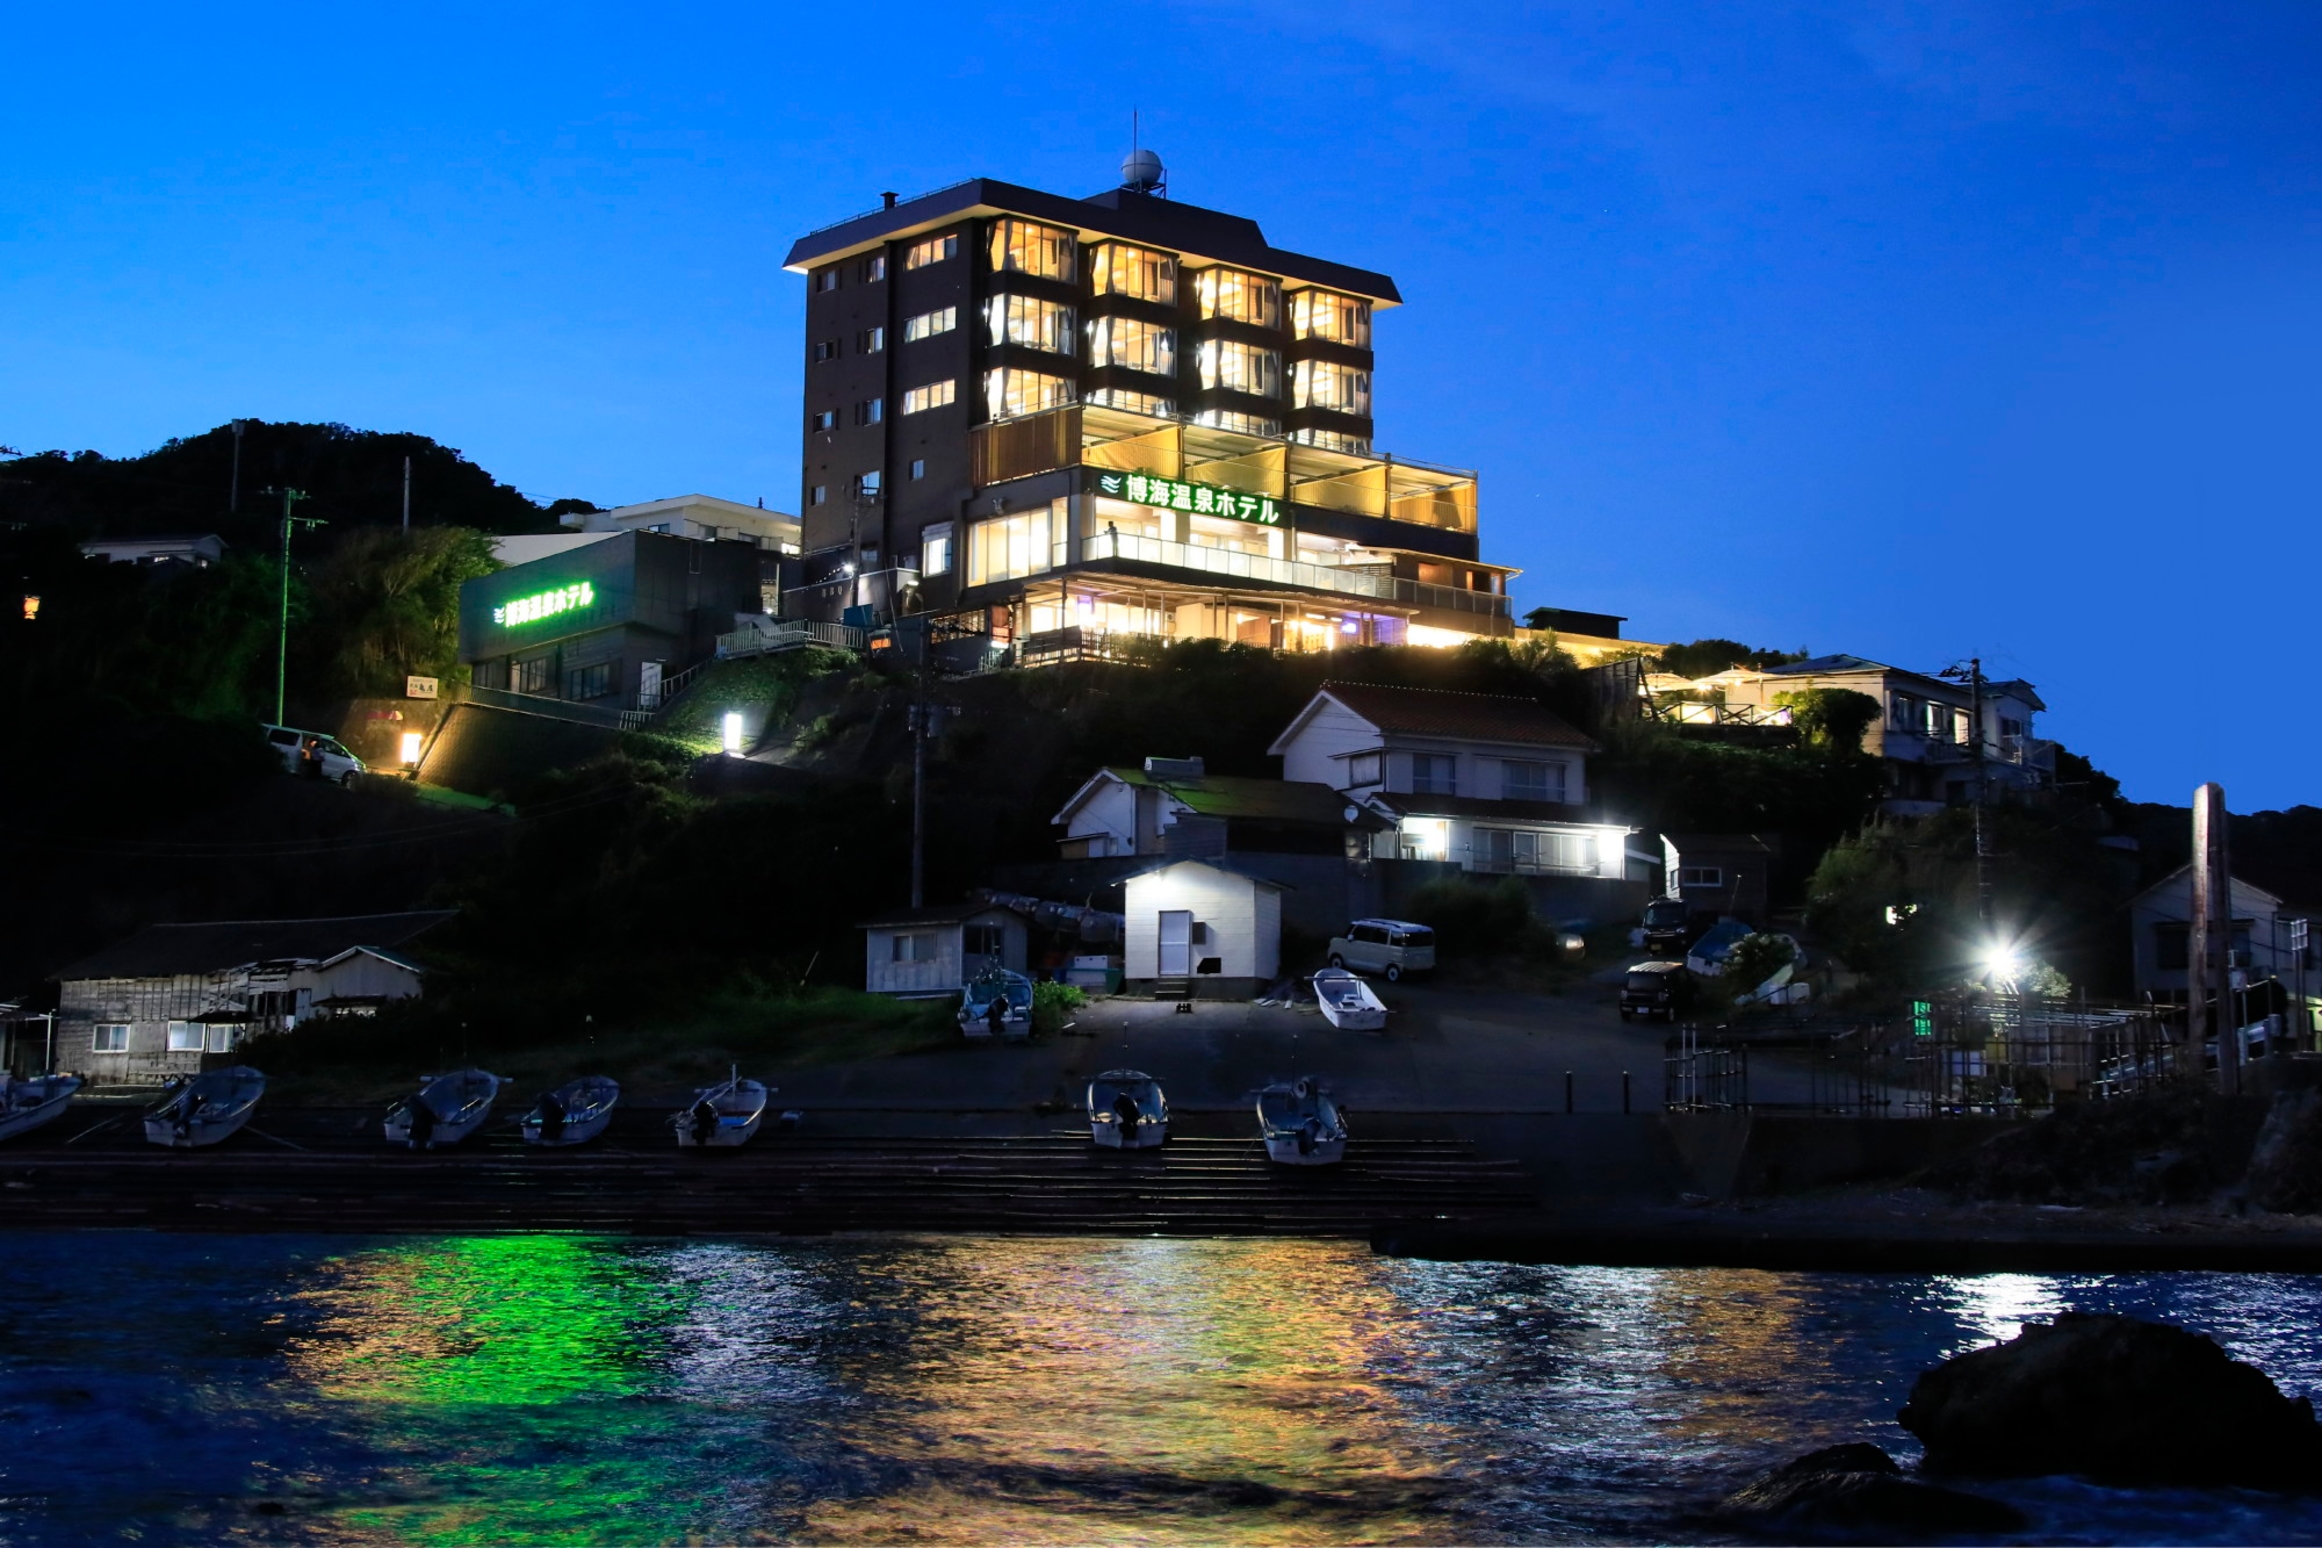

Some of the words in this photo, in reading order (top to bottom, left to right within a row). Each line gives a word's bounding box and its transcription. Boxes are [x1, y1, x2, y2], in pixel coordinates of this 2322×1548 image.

[1126, 474, 1279, 524] 博海温泉ホテル
